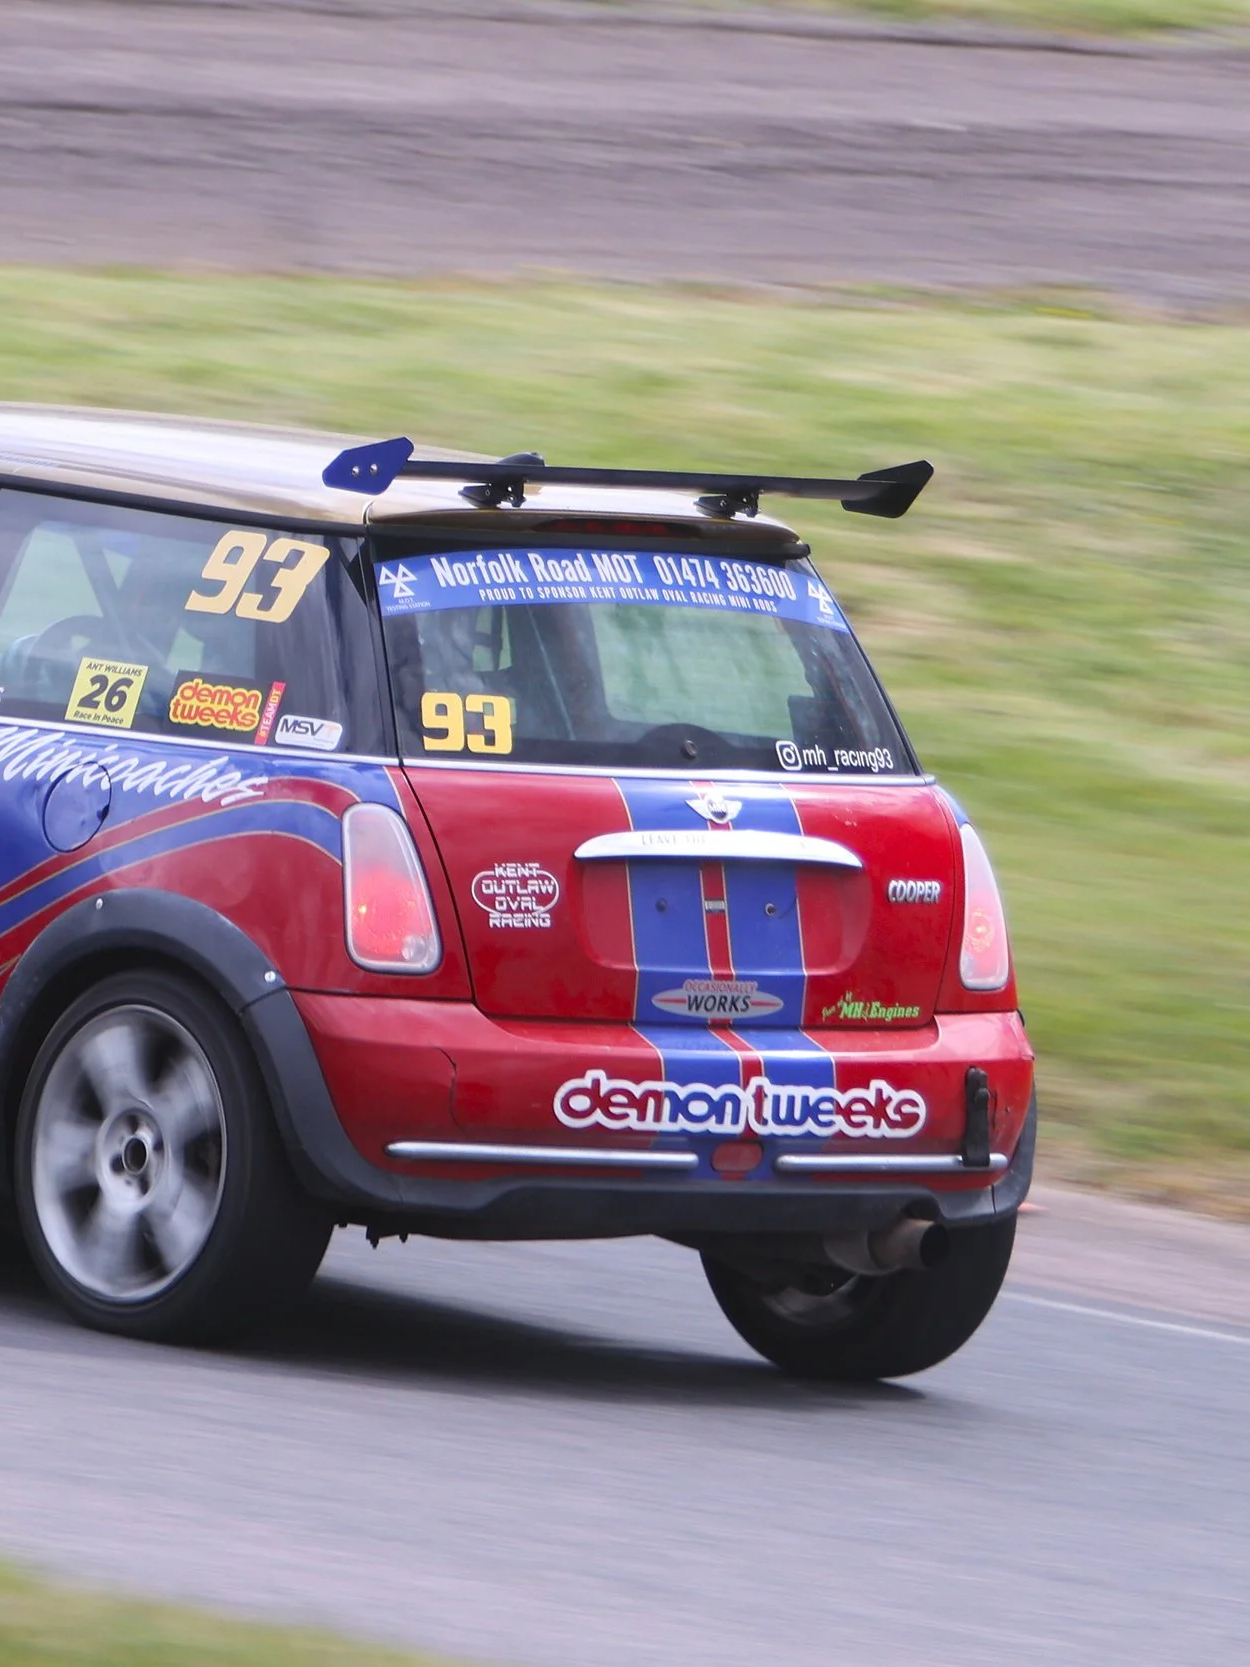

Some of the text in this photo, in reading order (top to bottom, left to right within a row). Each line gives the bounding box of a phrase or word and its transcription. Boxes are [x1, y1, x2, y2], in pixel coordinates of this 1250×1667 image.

[184, 530, 331, 623] 93
[430, 552, 797, 601] Norfolk Road MOT 01474 363600
[478, 586, 778, 613] PROUD TO SPONSOR KENT OUTLAW OVAL RACING MINI RODS
[86, 662, 143, 677] ANT WILLIAMS
[77, 674, 134, 713] 26
[178, 679, 261, 710] demon
[73, 710, 92, 720] Race
[102, 714, 124, 725] Peace
[171, 698, 257, 729] tweeks
[421, 691, 513, 755] 93
[802, 744, 894, 773] mh_racing93
[494, 863, 540, 878] KENT
[481, 879, 555, 895] OUTLAW
[888, 879, 941, 904] COOPER
[495, 896, 544, 911] OVAL
[488, 913, 551, 928] RACING
[684, 980, 757, 995] OCCASIONALLY
[686, 994, 751, 1013] WORKS
[869, 1001, 920, 1022] Engines
[556, 1072, 926, 1135] demon tweeks
